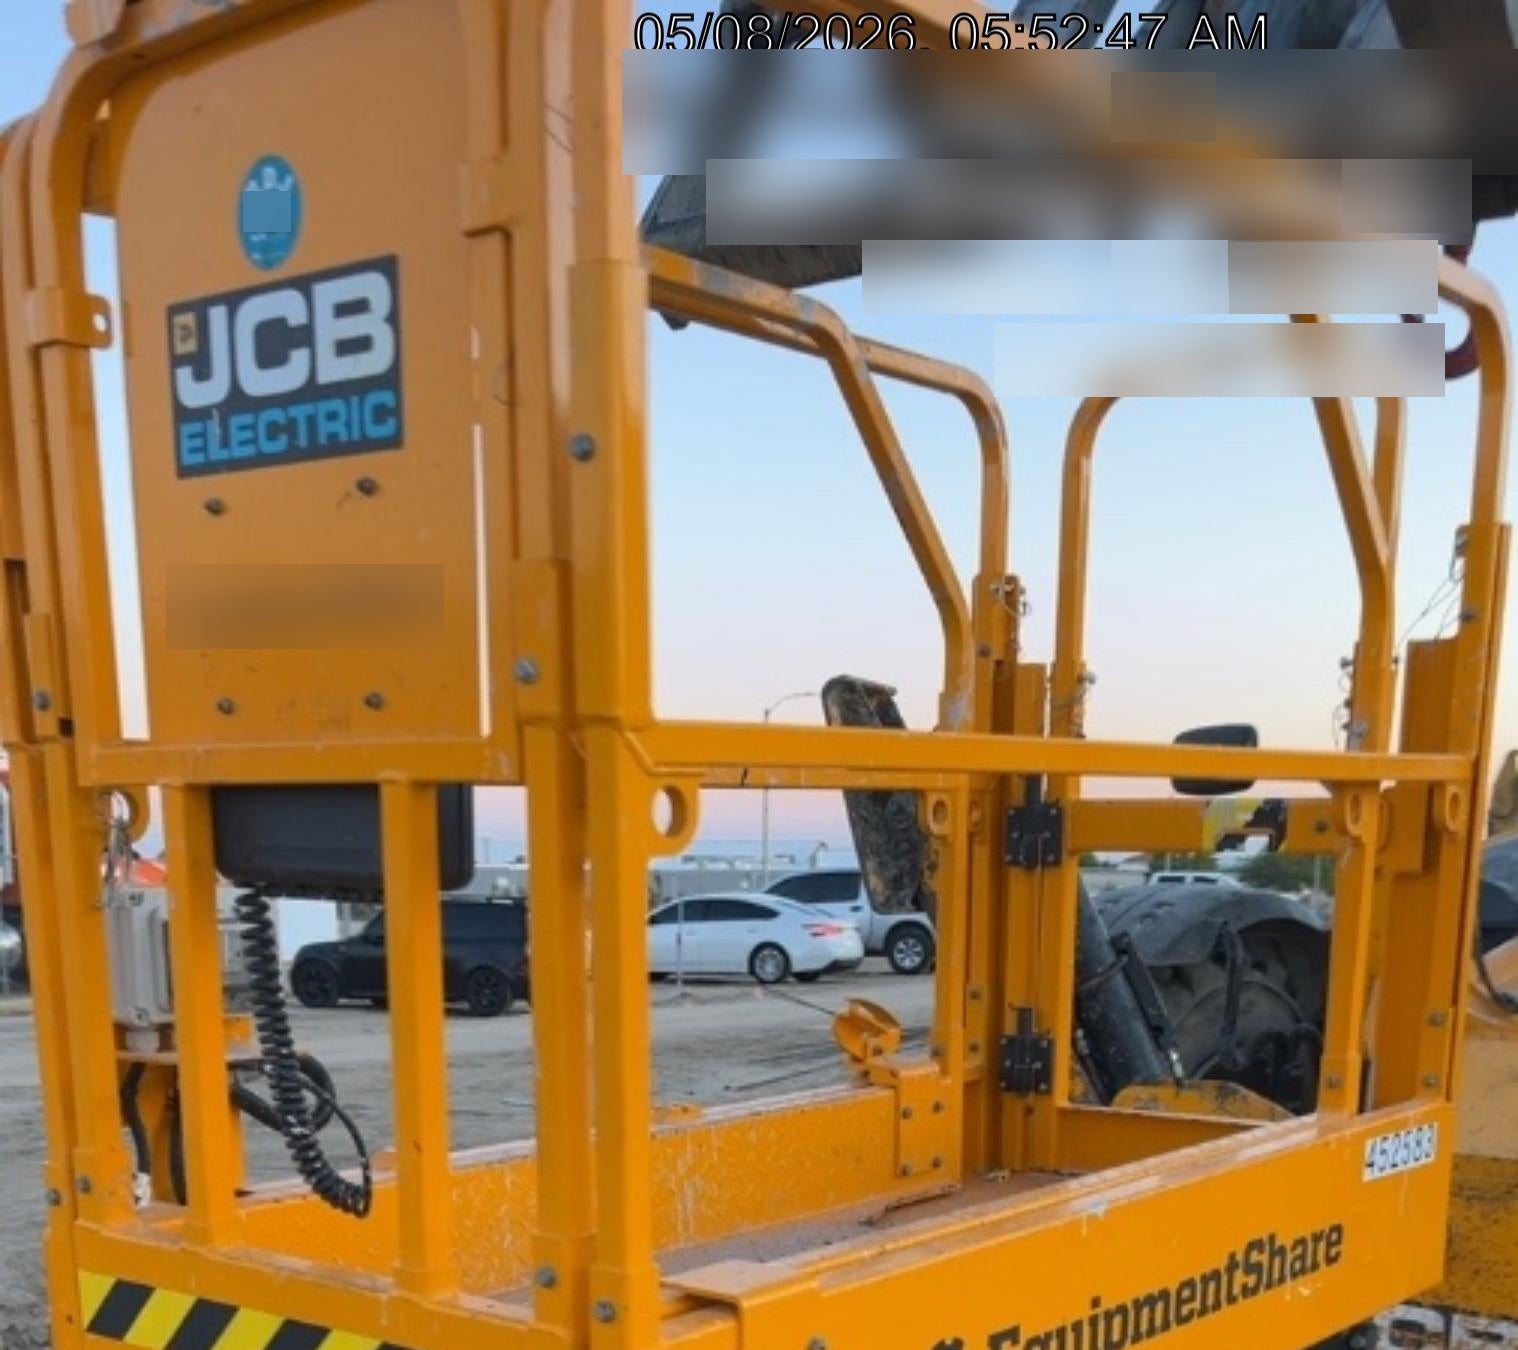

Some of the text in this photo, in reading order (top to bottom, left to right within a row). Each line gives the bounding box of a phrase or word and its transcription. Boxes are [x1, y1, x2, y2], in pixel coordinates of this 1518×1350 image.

[175, 271, 395, 409] JCB
[179, 389, 398, 467] ELECTRIC
[1366, 1124, 1435, 1174] 452583
